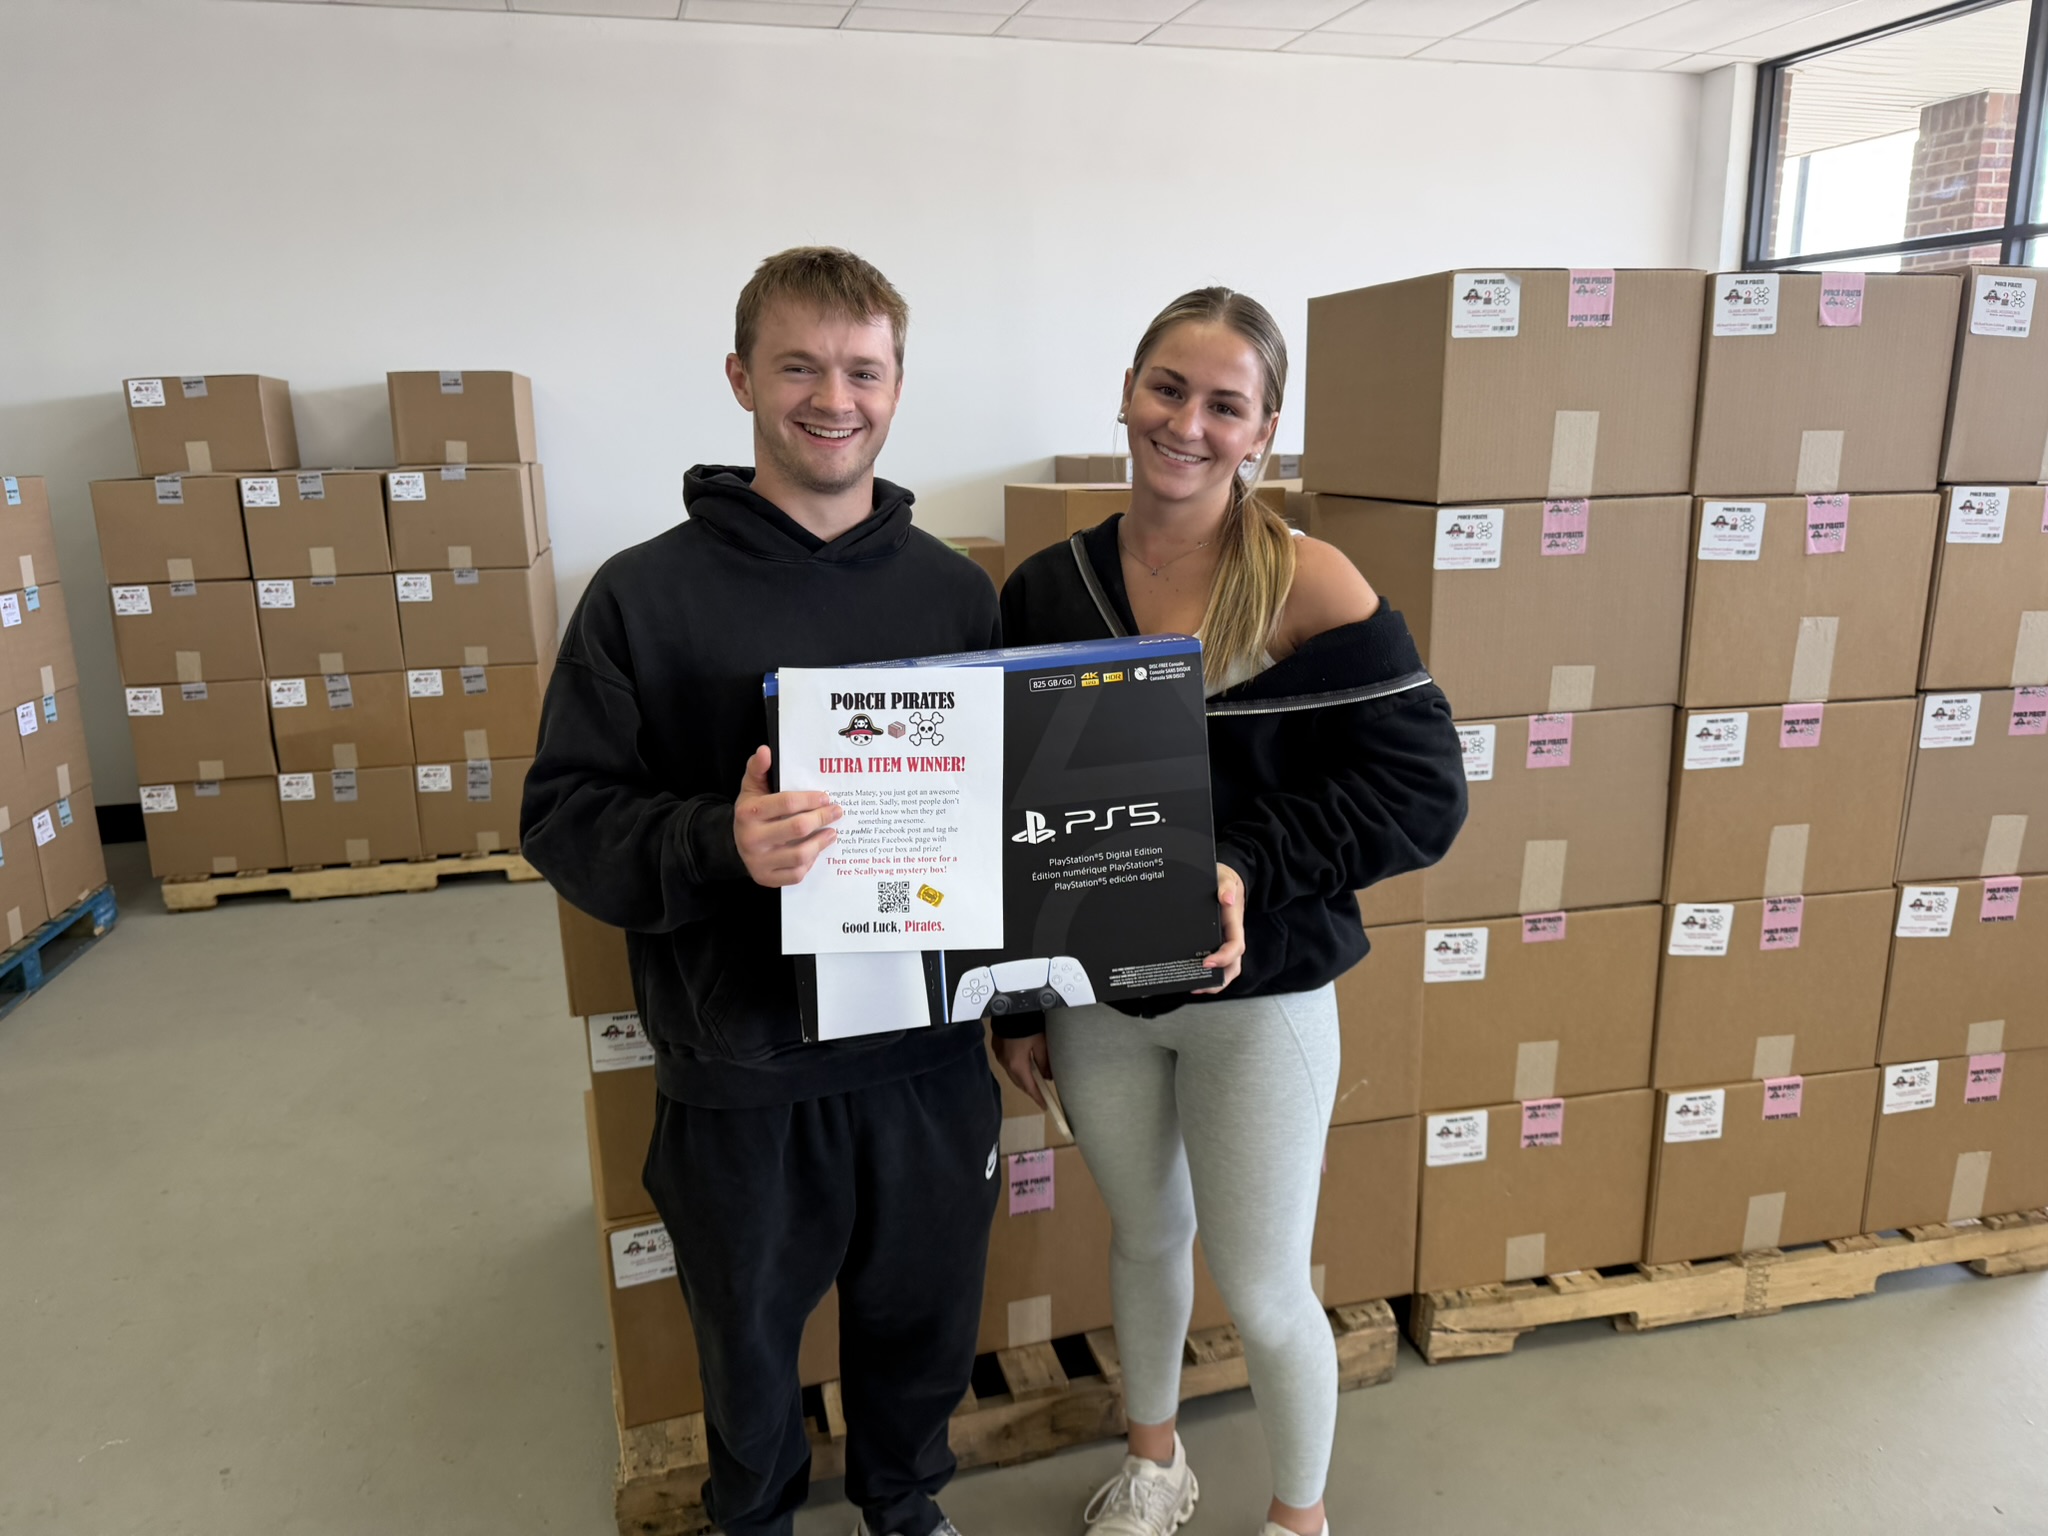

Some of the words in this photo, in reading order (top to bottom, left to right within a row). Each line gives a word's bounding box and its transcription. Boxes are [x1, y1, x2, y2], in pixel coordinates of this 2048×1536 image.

[1033, 680, 1046, 689] 825
[1048, 678, 1072, 688] GB/Go
[830, 692, 886, 710] PORCH
[890, 691, 955, 710] PIRATES
[819, 757, 863, 773] ULTRA
[868, 756, 902, 772] ITEM
[907, 756, 966, 772] WINNER!
[855, 790, 878, 798] Matey,
[879, 790, 892, 798] you
[893, 789, 905, 797] just
[879, 799, 899, 807] Sadly,
[847, 808, 858, 816] the
[860, 808, 879, 816] world
[920, 807, 934, 816] they
[936, 808, 946, 816] get
[858, 818, 892, 826] something
[1064, 802, 1161, 834] PS5
[850, 827, 873, 836] public
[874, 826, 905, 834] Facebook
[907, 827, 921, 835] post
[936, 827, 946, 835] tag
[882, 836, 913, 844] Facebook
[932, 835, 947, 843] with
[842, 847, 868, 855] pictures
[922, 846, 942, 854] prize!
[1106, 848, 1133, 861] Digital
[1134, 846, 1163, 857] Edition
[826, 857, 847, 865] Then
[872, 856, 892, 864] back
[893, 856, 901, 864] in
[939, 855, 951, 863] for
[837, 868, 852, 876] free
[854, 867, 894, 876] Scallywag
[896, 867, 927, 876] mystery
[930, 866, 947, 874] box!
[1032, 870, 1060, 881] Édition
[1062, 863, 1107, 879] numérique
[1109, 872, 1138, 885] edición
[1140, 870, 1165, 882] digital
[842, 922, 870, 934] Good
[873, 921, 901, 934] Luck,
[905, 920, 945, 932] Pirates.
